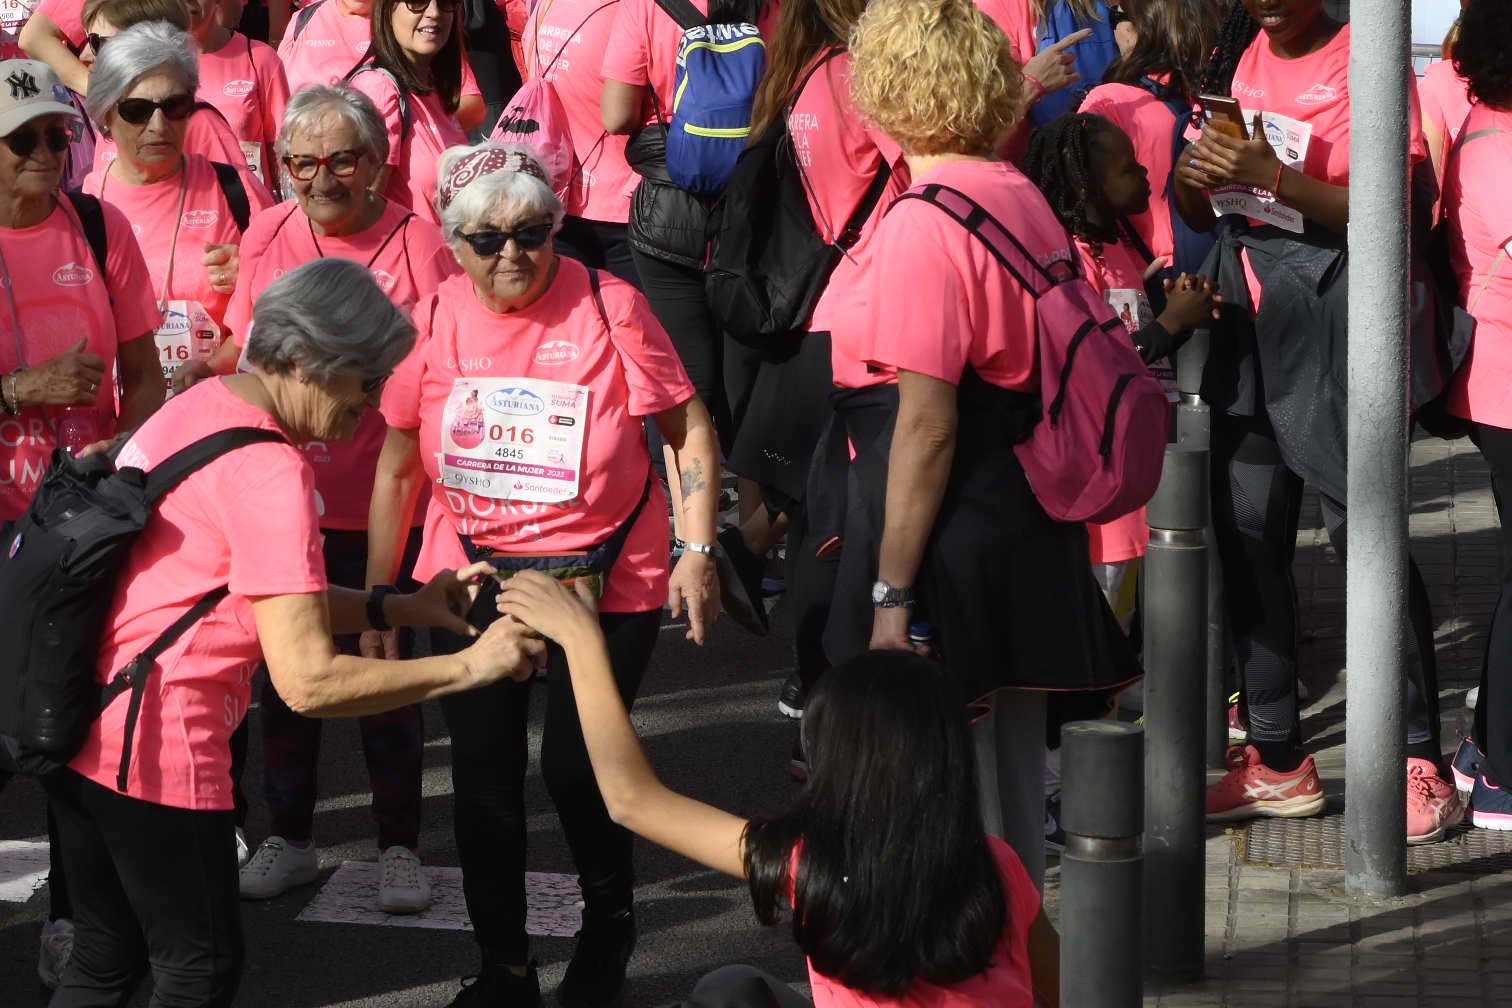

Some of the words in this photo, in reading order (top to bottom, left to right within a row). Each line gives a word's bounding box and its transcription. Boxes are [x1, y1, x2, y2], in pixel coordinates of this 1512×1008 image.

[490, 396, 540, 413] ASTURIANA
[489, 424, 535, 444] 016
[494, 447, 524, 460] 4845
[456, 458, 492, 470] CARRERA
[493, 463, 505, 472] DE
[506, 464, 517, 472] LA
[517, 465, 546, 476] MUJER
